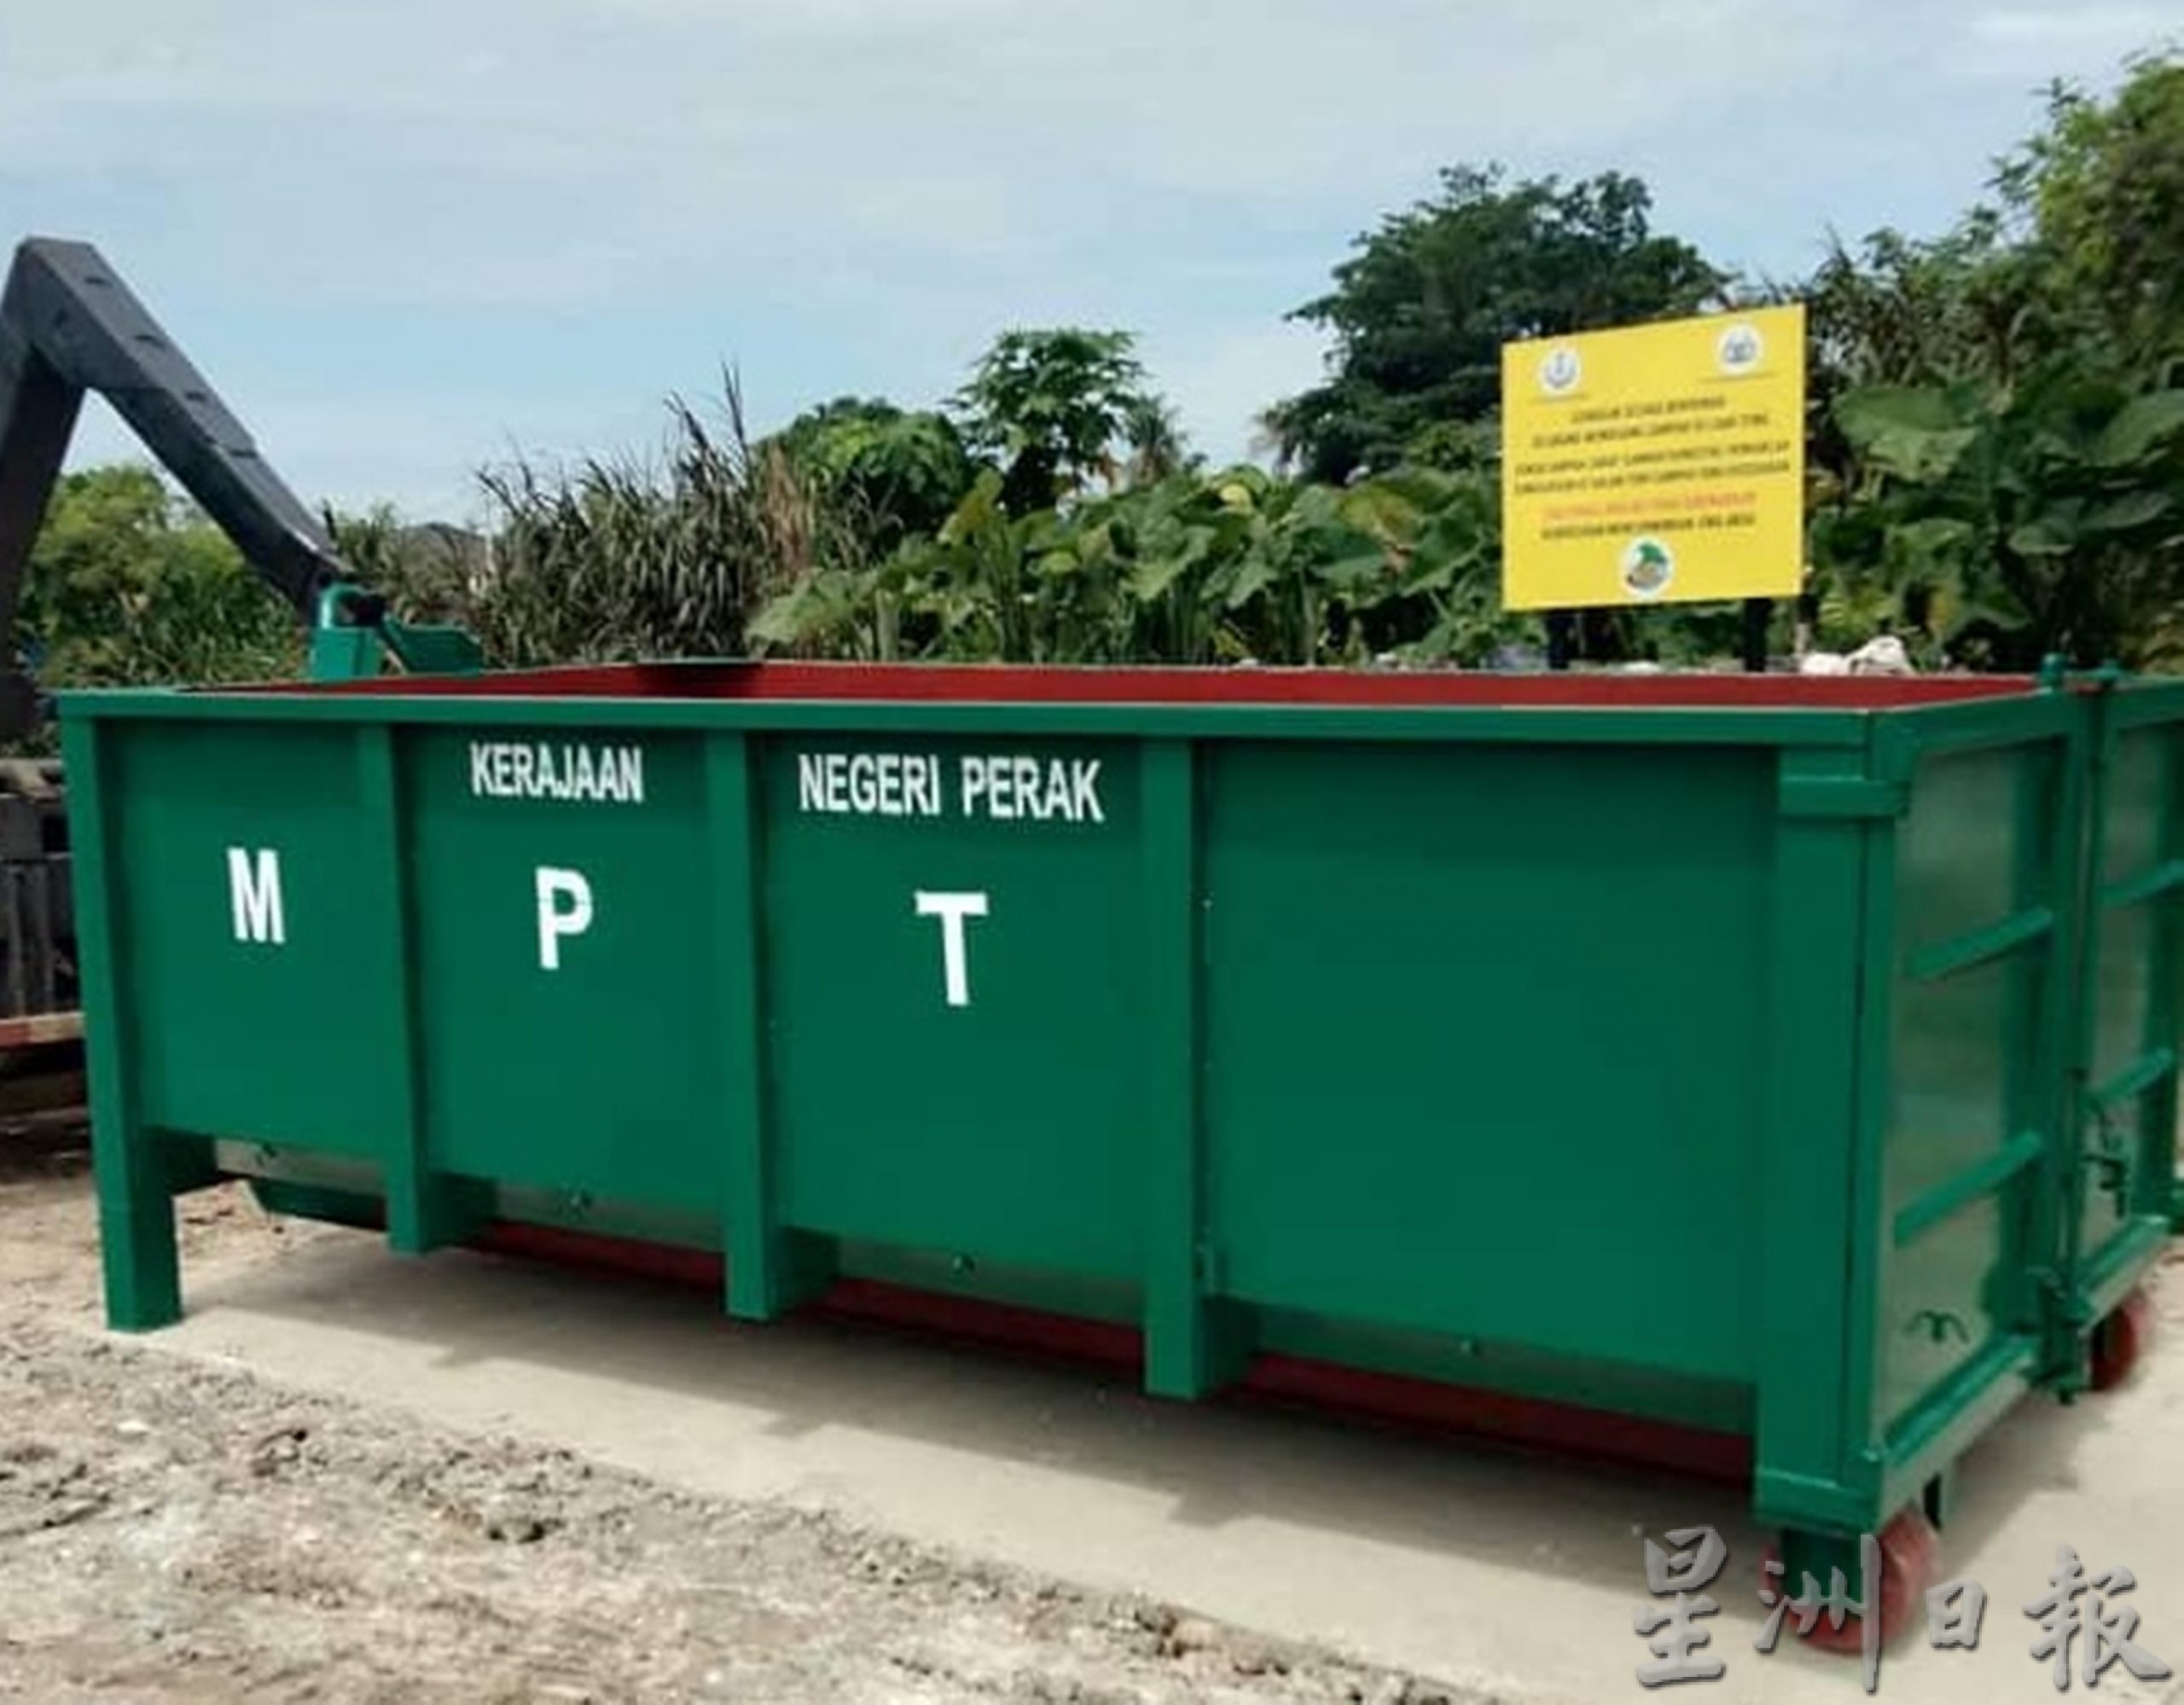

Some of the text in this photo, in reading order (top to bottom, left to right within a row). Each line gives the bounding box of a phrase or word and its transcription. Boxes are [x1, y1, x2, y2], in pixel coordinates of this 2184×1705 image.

[471, 744, 1104, 823] KERAJAAN NEGERI PERAK
[228, 847, 989, 1006] M P T
